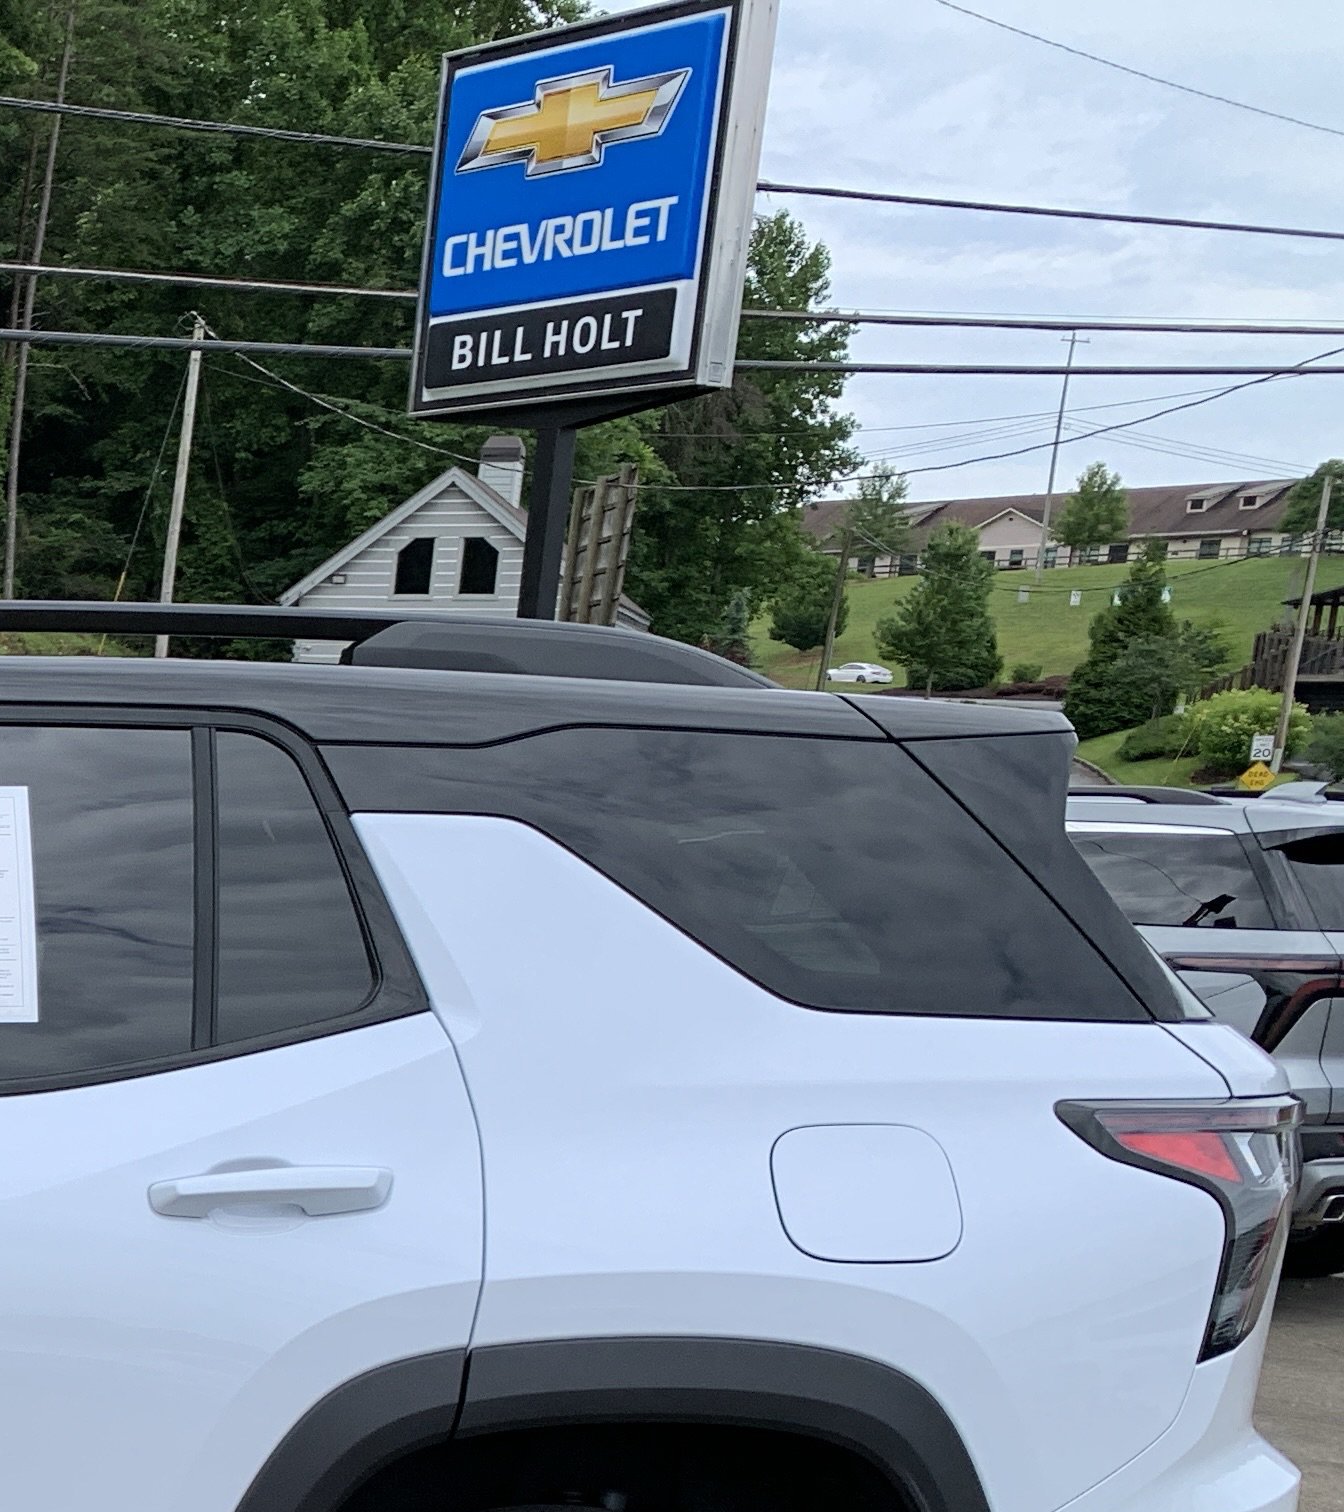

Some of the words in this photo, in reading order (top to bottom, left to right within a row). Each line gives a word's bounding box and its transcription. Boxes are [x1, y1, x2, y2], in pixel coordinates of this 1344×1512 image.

[442, 196, 679, 278] CHEVROLET
[450, 326, 533, 371] BILL
[543, 309, 643, 359] HOLT
[1253, 748, 1271, 757] 20
